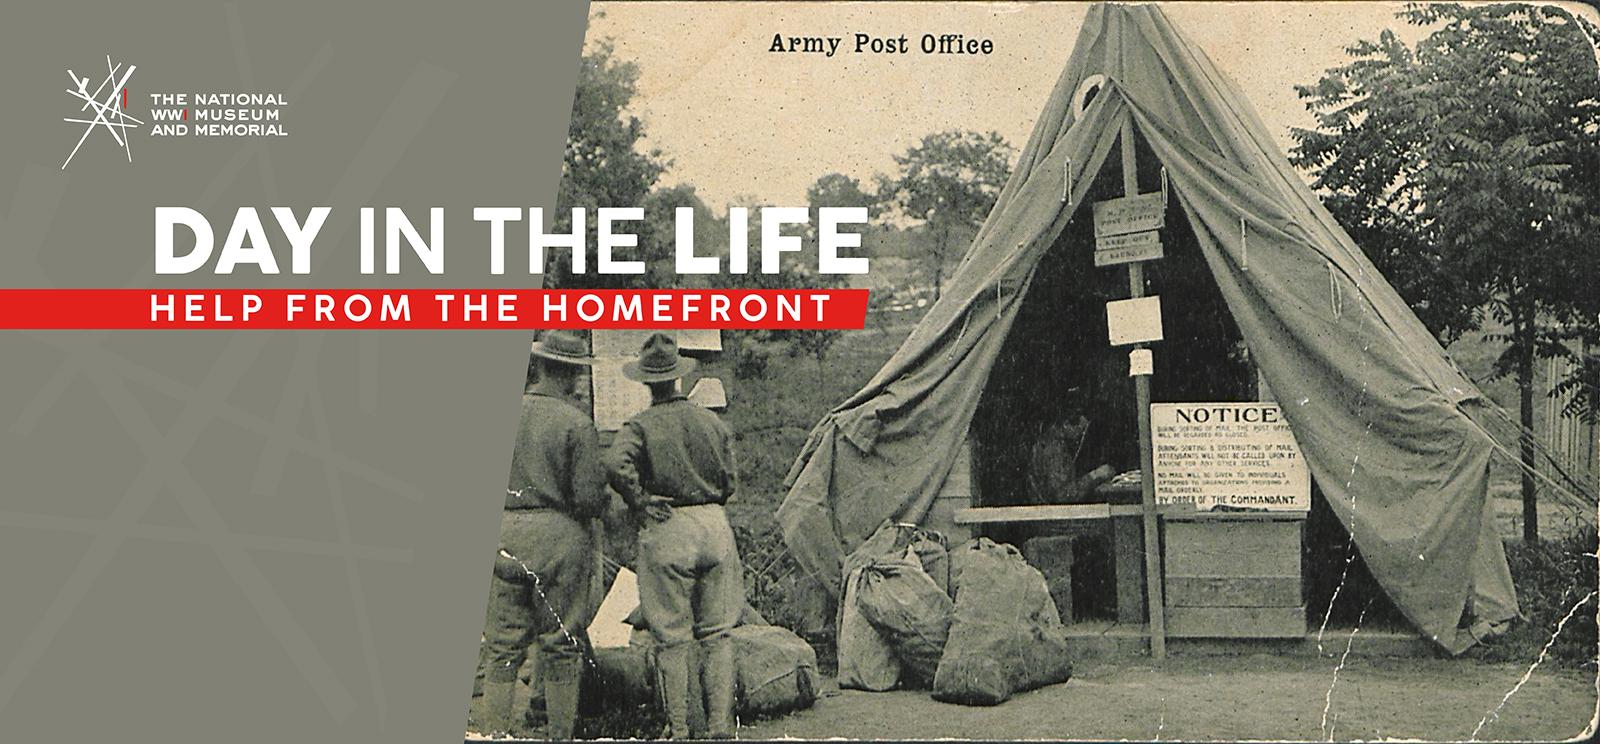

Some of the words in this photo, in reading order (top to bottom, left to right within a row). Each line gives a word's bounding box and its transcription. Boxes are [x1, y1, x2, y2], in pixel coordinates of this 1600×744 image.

[1176, 407, 1278, 424] NOTICE
[1172, 496, 1196, 504] ORDER
[1198, 496, 1207, 504] OF
[1211, 496, 1228, 504] THE
